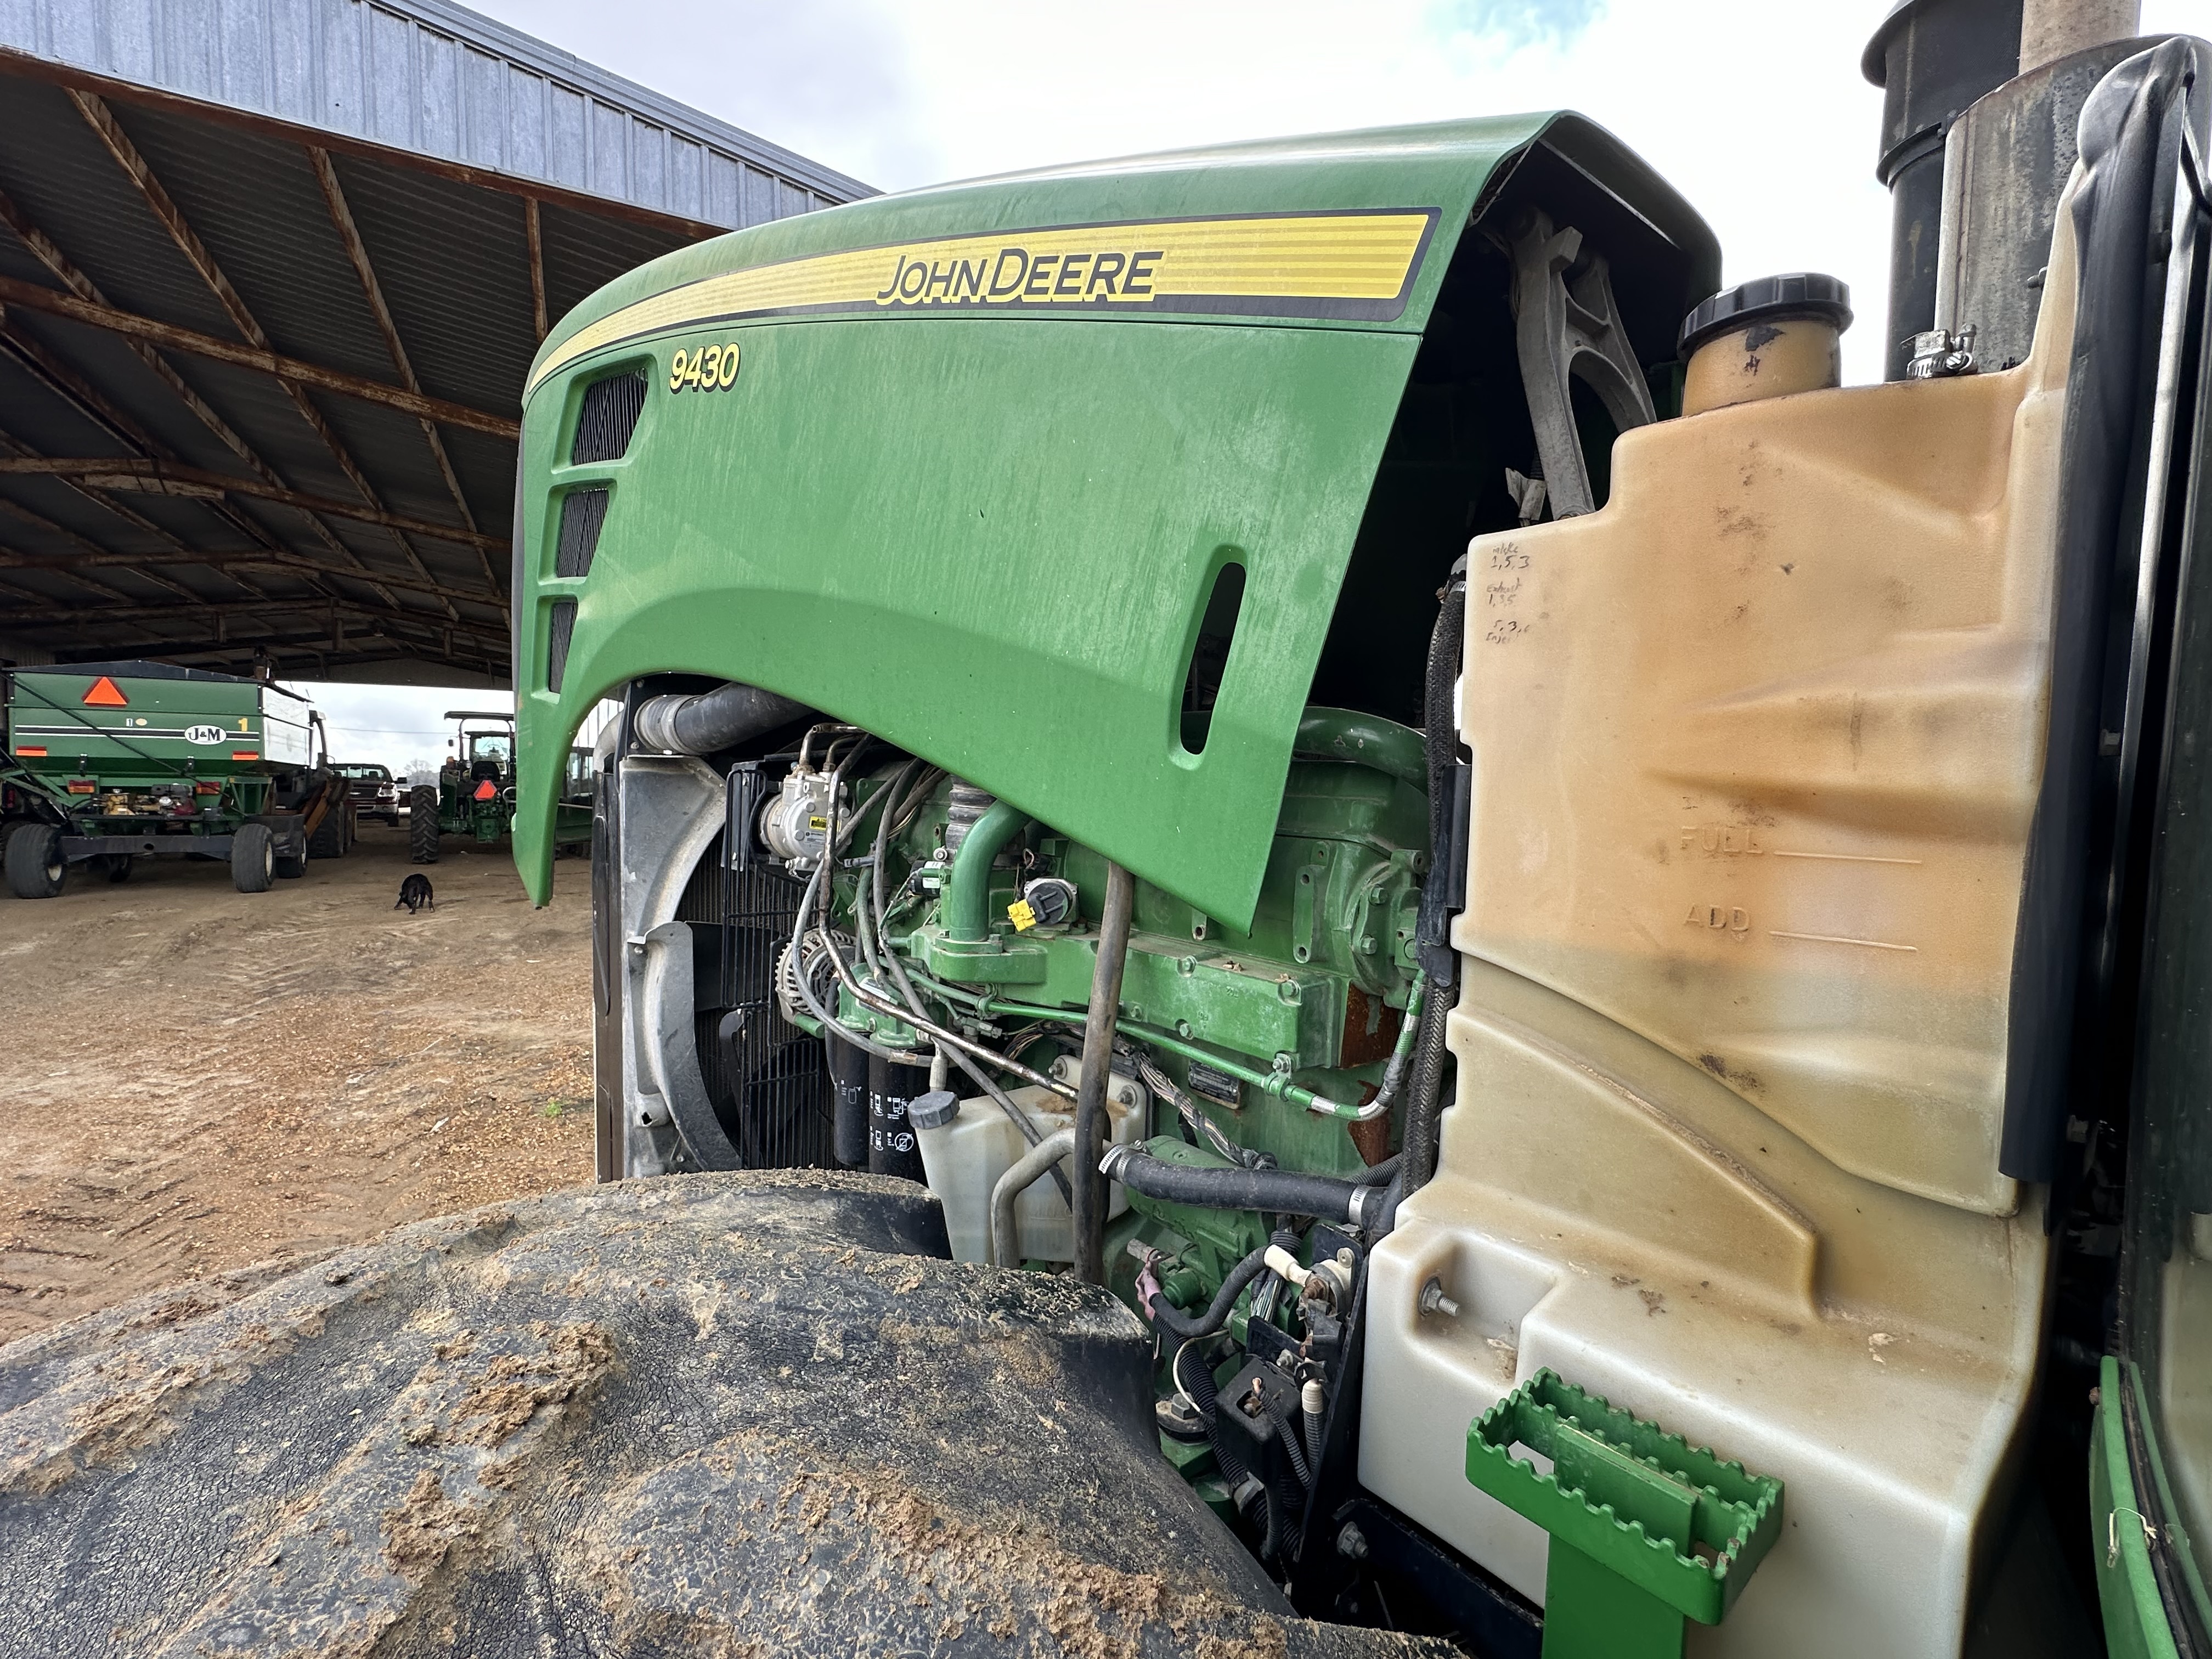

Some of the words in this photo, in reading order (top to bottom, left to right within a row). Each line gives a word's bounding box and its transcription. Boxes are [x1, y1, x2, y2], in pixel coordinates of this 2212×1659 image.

[876, 254, 986, 305] JOHN
[986, 248, 1164, 303] DEERE
[670, 342, 741, 394] 9430
[188, 728, 221, 741] J&M
[238, 718, 248, 731] 1
[1681, 825, 1764, 854] FULL
[1683, 904, 1750, 932] ADD
